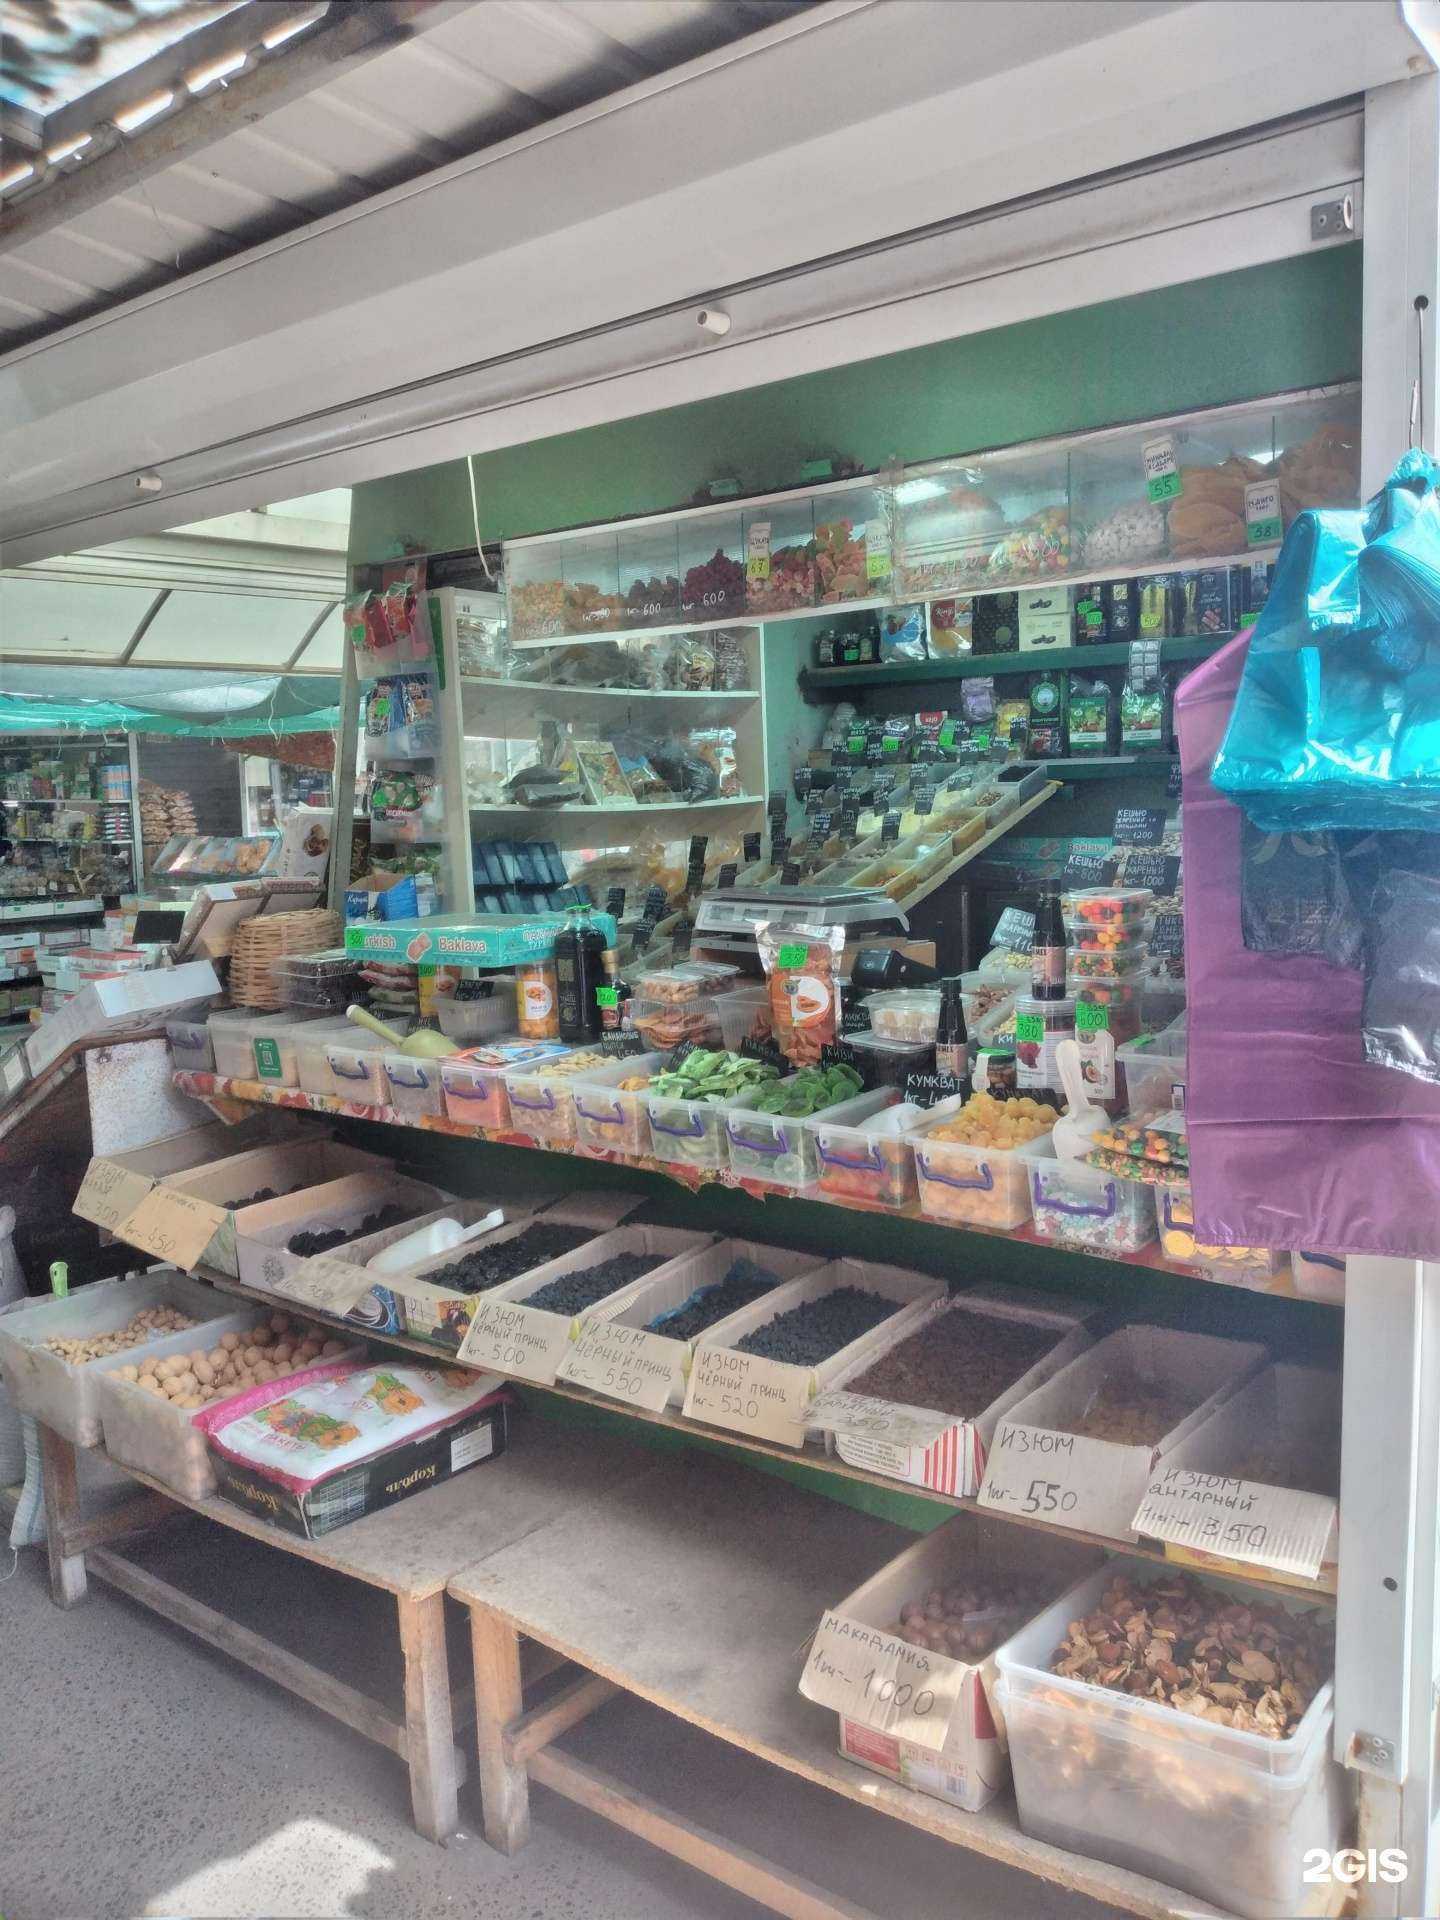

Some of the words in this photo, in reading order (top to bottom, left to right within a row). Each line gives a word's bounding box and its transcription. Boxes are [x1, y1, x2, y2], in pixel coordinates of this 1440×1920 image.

[643, 602, 661, 616] 600
[1068, 854, 1104, 869] КЕШЬЮ
[439, 937, 487, 953] Baklava
[907, 1073, 965, 1091] КУМКВАТ
[480, 1303, 526, 1329] ИЗЮМ
[587, 1320, 647, 1346] ИЗЮМ
[491, 1344, 526, 1365] 500
[701, 1351, 750, 1373] ИЗЮМ
[602, 1368, 642, 1396] 550
[750, 1383, 786, 1404] ПРИНЦ
[720, 1394, 760, 1418] 520
[1000, 1426, 1075, 1457] ИЗЮМ
[1163, 1467, 1244, 1495] ИЗЮМ
[1022, 1480, 1079, 1513] 550
[1202, 1516, 1268, 1548] 350
[863, 1667, 936, 1716] 1000
